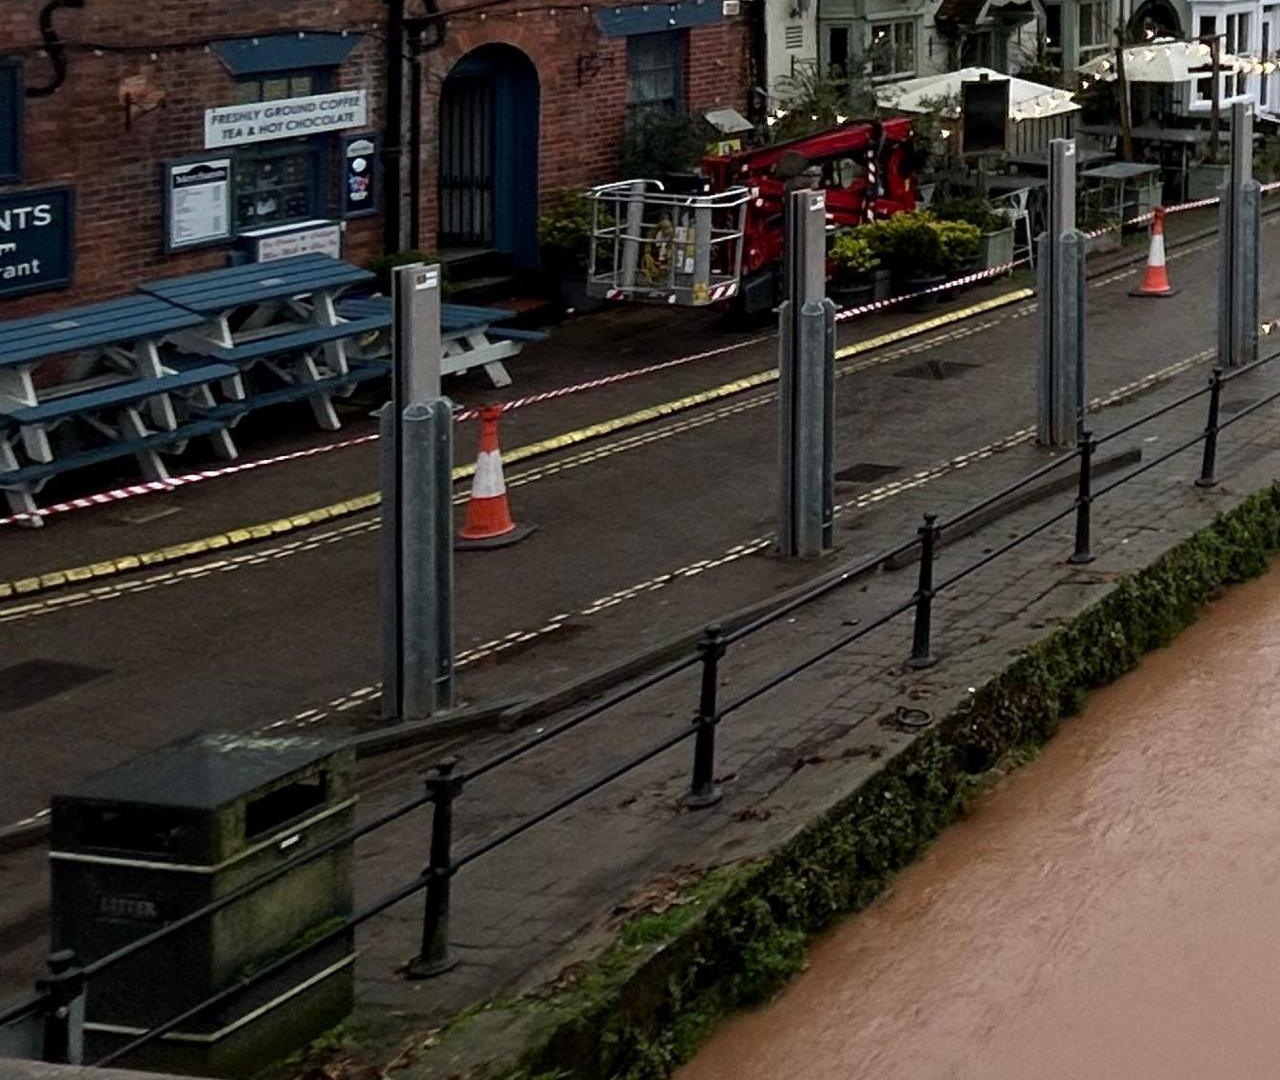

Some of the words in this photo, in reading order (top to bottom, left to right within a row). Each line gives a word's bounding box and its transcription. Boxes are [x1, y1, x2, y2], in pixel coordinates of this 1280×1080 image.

[211, 109, 260, 125] FRESHLY
[264, 103, 316, 118] GROUND
[319, 96, 360, 111] COFFEE
[222, 128, 243, 140] TEA
[247, 126, 255, 137] &
[259, 122, 284, 134] HOT
[286, 112, 355, 131] CHOCOLATE
[0, 259, 40, 279] ant
